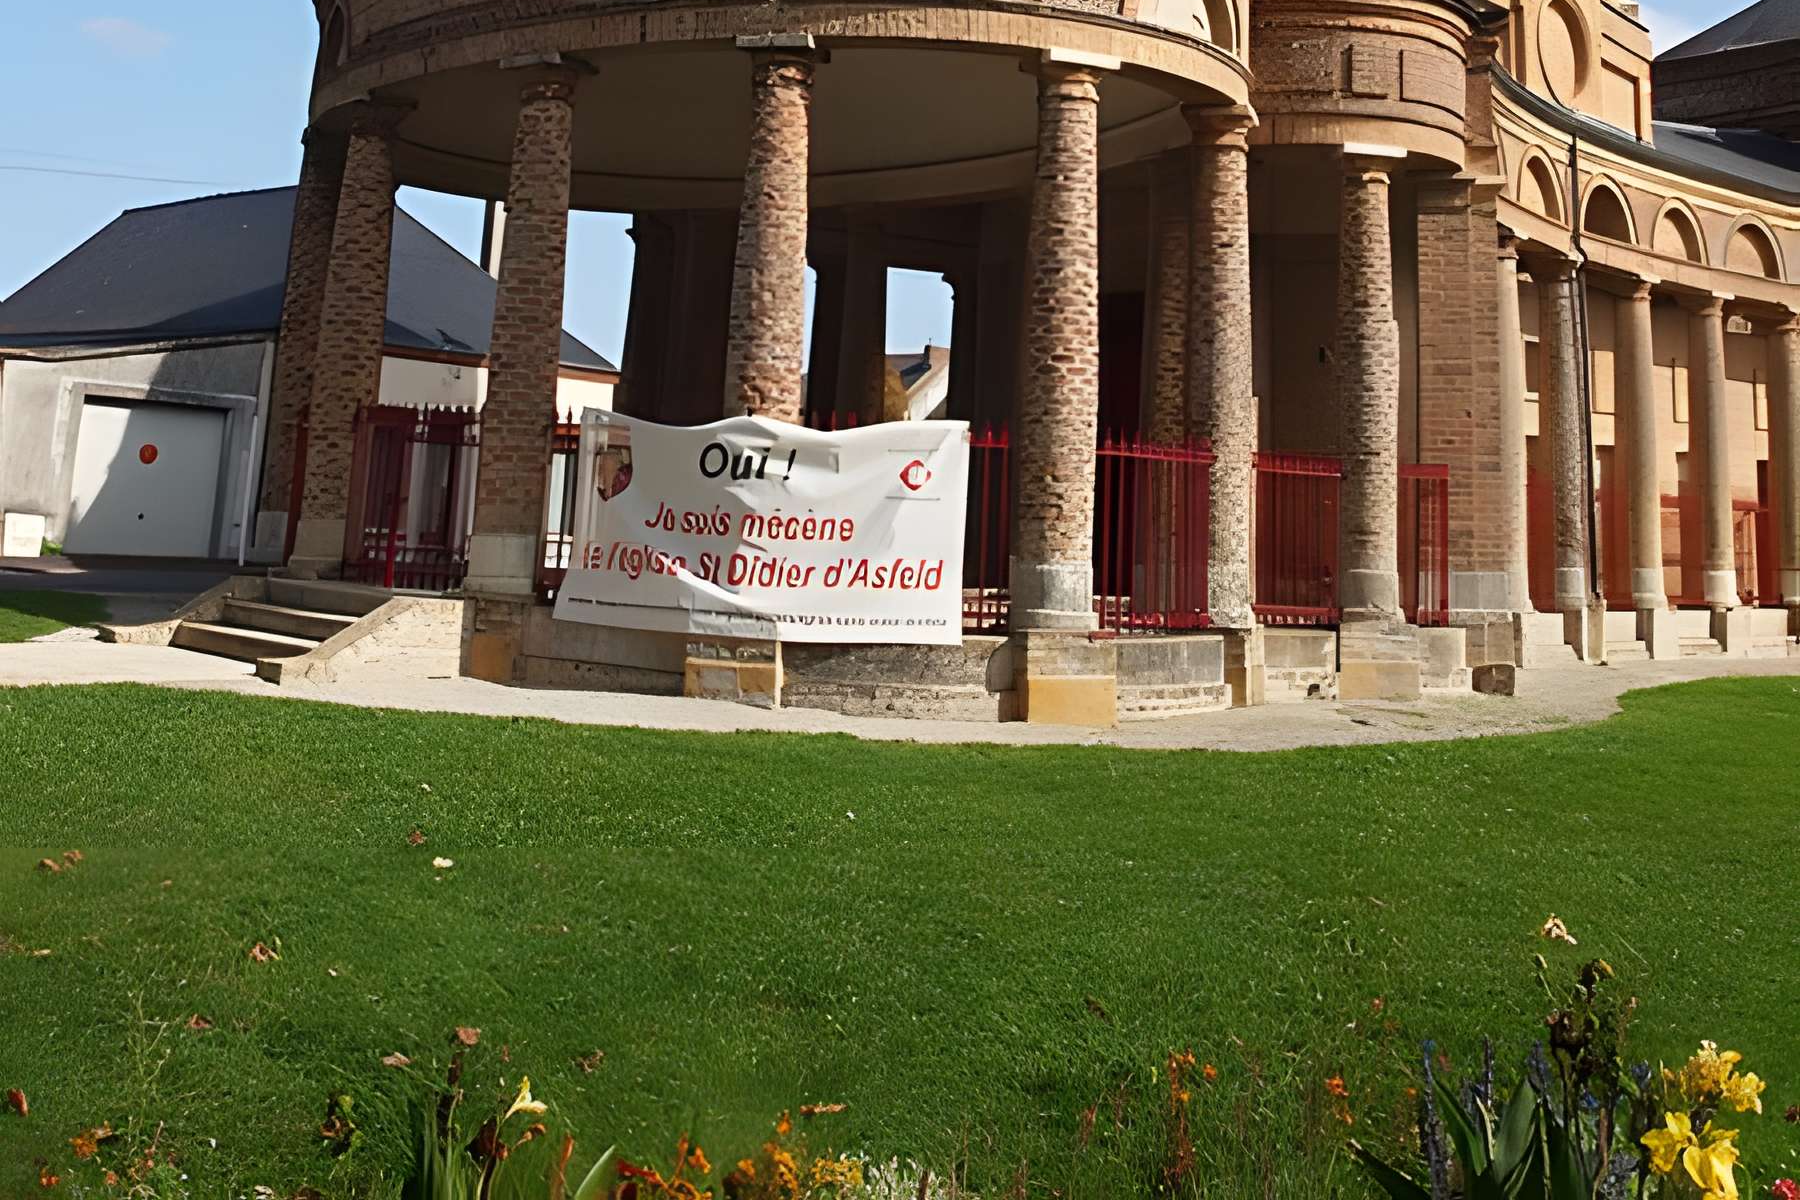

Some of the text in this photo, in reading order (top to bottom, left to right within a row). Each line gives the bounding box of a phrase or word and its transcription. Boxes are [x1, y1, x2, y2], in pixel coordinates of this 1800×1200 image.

[700, 442, 797, 481] Oui !
[727, 552, 816, 588] Didier
[823, 558, 944, 591] d'Asfeld
